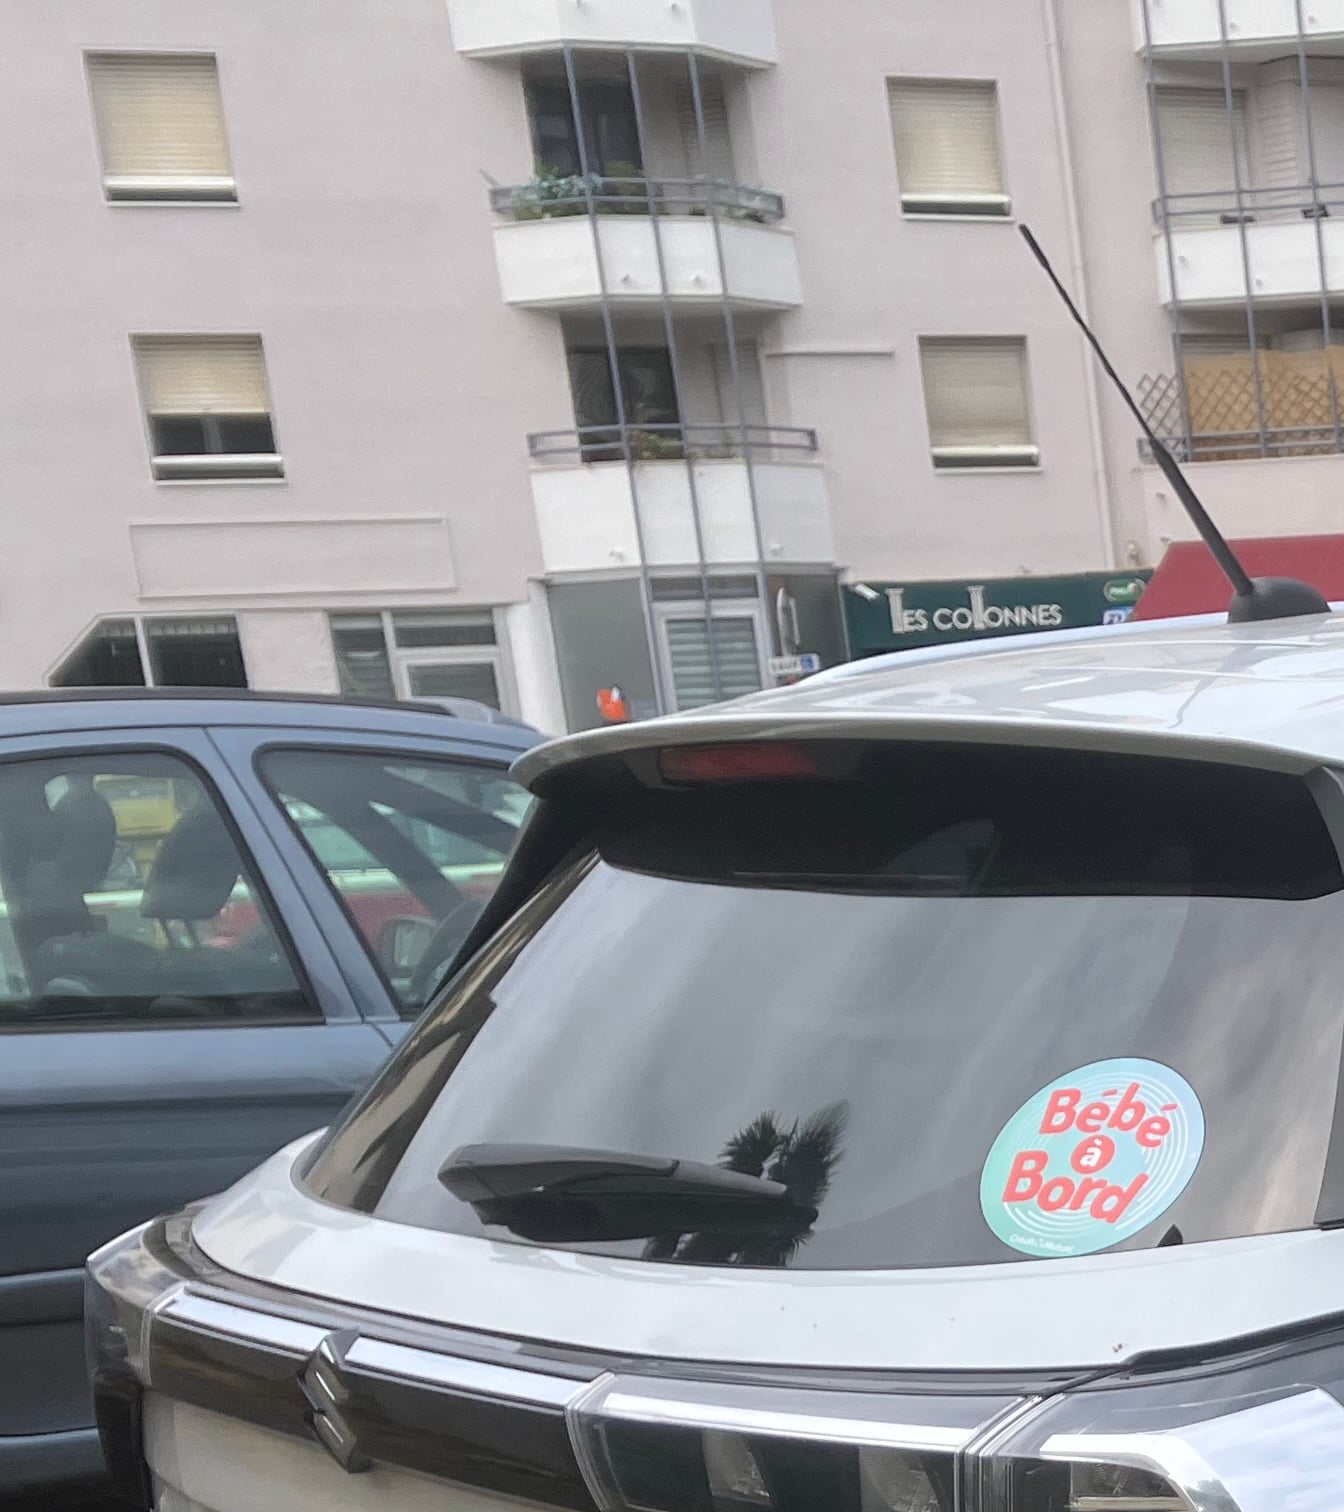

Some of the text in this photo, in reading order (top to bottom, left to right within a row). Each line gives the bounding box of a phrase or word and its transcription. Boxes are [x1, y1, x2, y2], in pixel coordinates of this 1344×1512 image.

[885, 585, 1062, 634] LES COLONNES
[1039, 1082, 1178, 1148] Bébé
[1080, 1138, 1102, 1168] à
[1002, 1150, 1149, 1224] Bord
